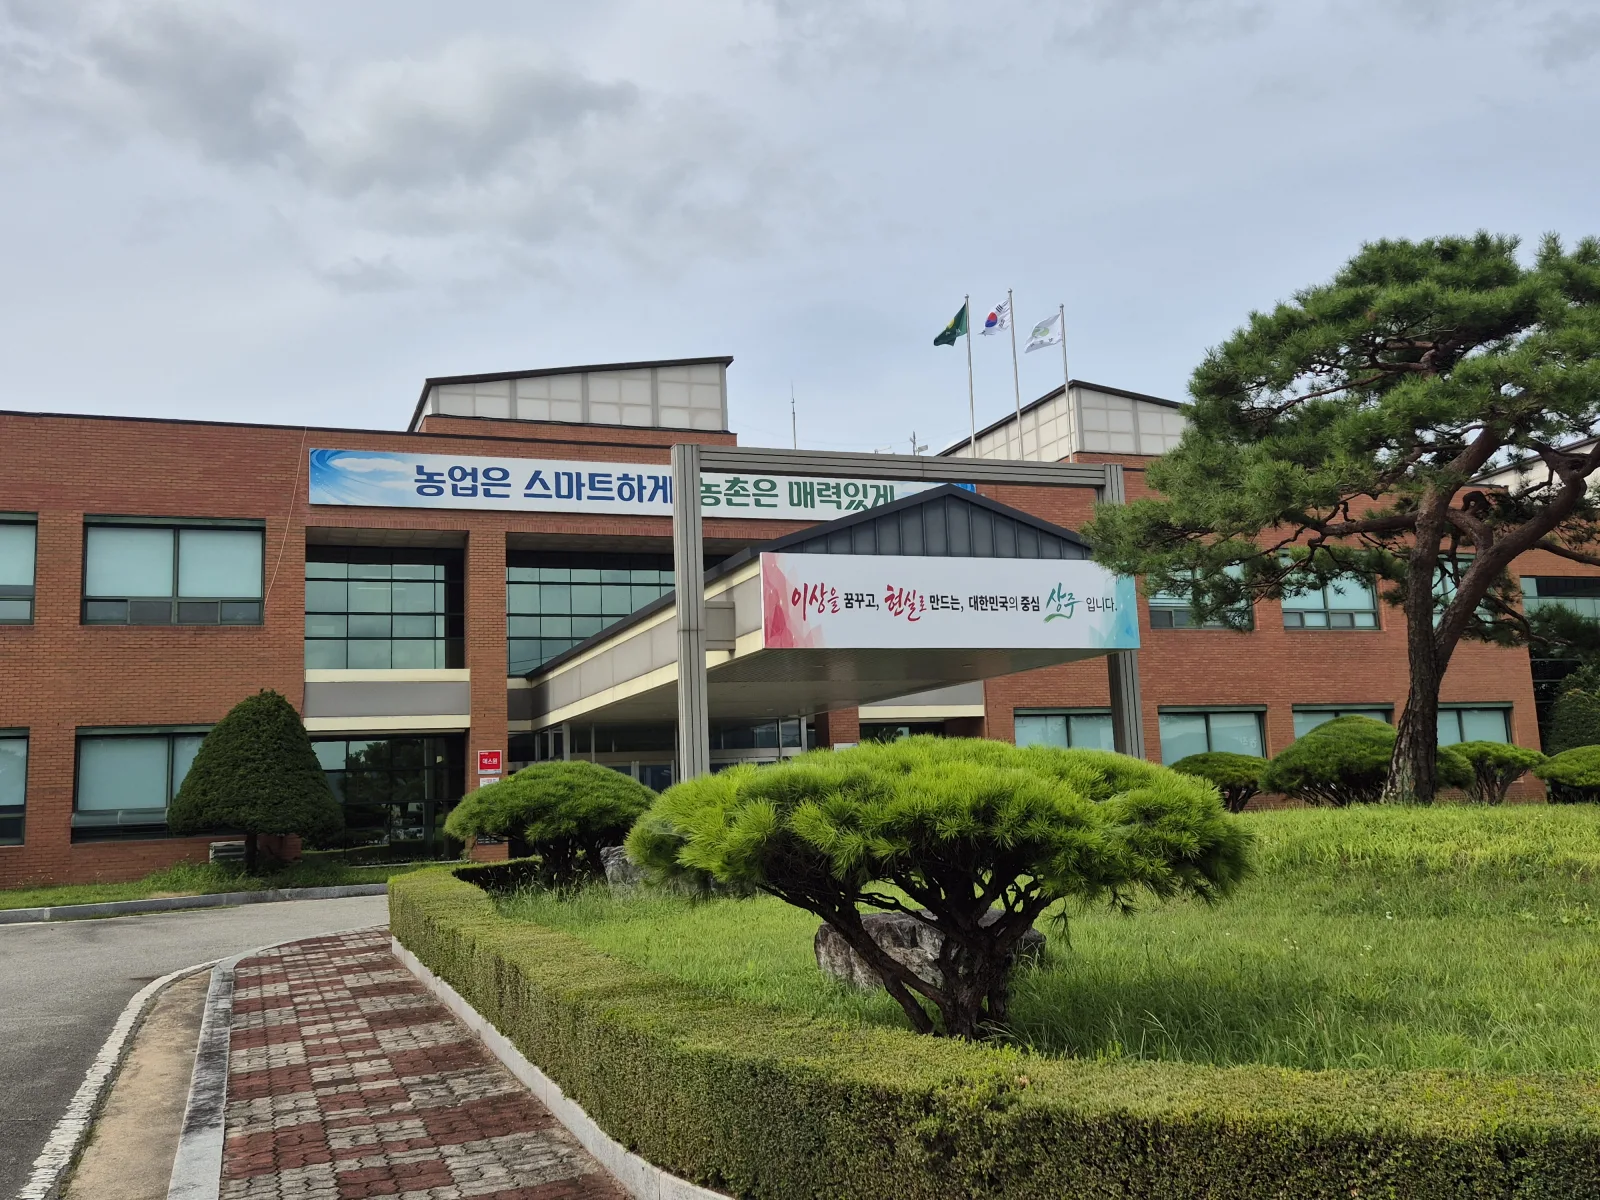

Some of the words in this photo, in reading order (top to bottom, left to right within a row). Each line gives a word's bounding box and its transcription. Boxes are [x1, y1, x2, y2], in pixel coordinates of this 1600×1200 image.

[414, 465, 512, 499] 농업은
[524, 470, 672, 503] 스마트하게
[700, 477, 778, 508] 농촌은
[788, 481, 895, 510] 매력있게
[791, 582, 841, 621] 이상을
[843, 593, 880, 611] 꿈꾸고,
[884, 584, 927, 622] 현실로
[929, 594, 964, 612] 만드는,
[968, 595, 1018, 612] 대한민국의
[1020, 595, 1040, 612] 중심
[1044, 582, 1084, 623] 상주
[1085, 597, 1118, 612] 입니다.
